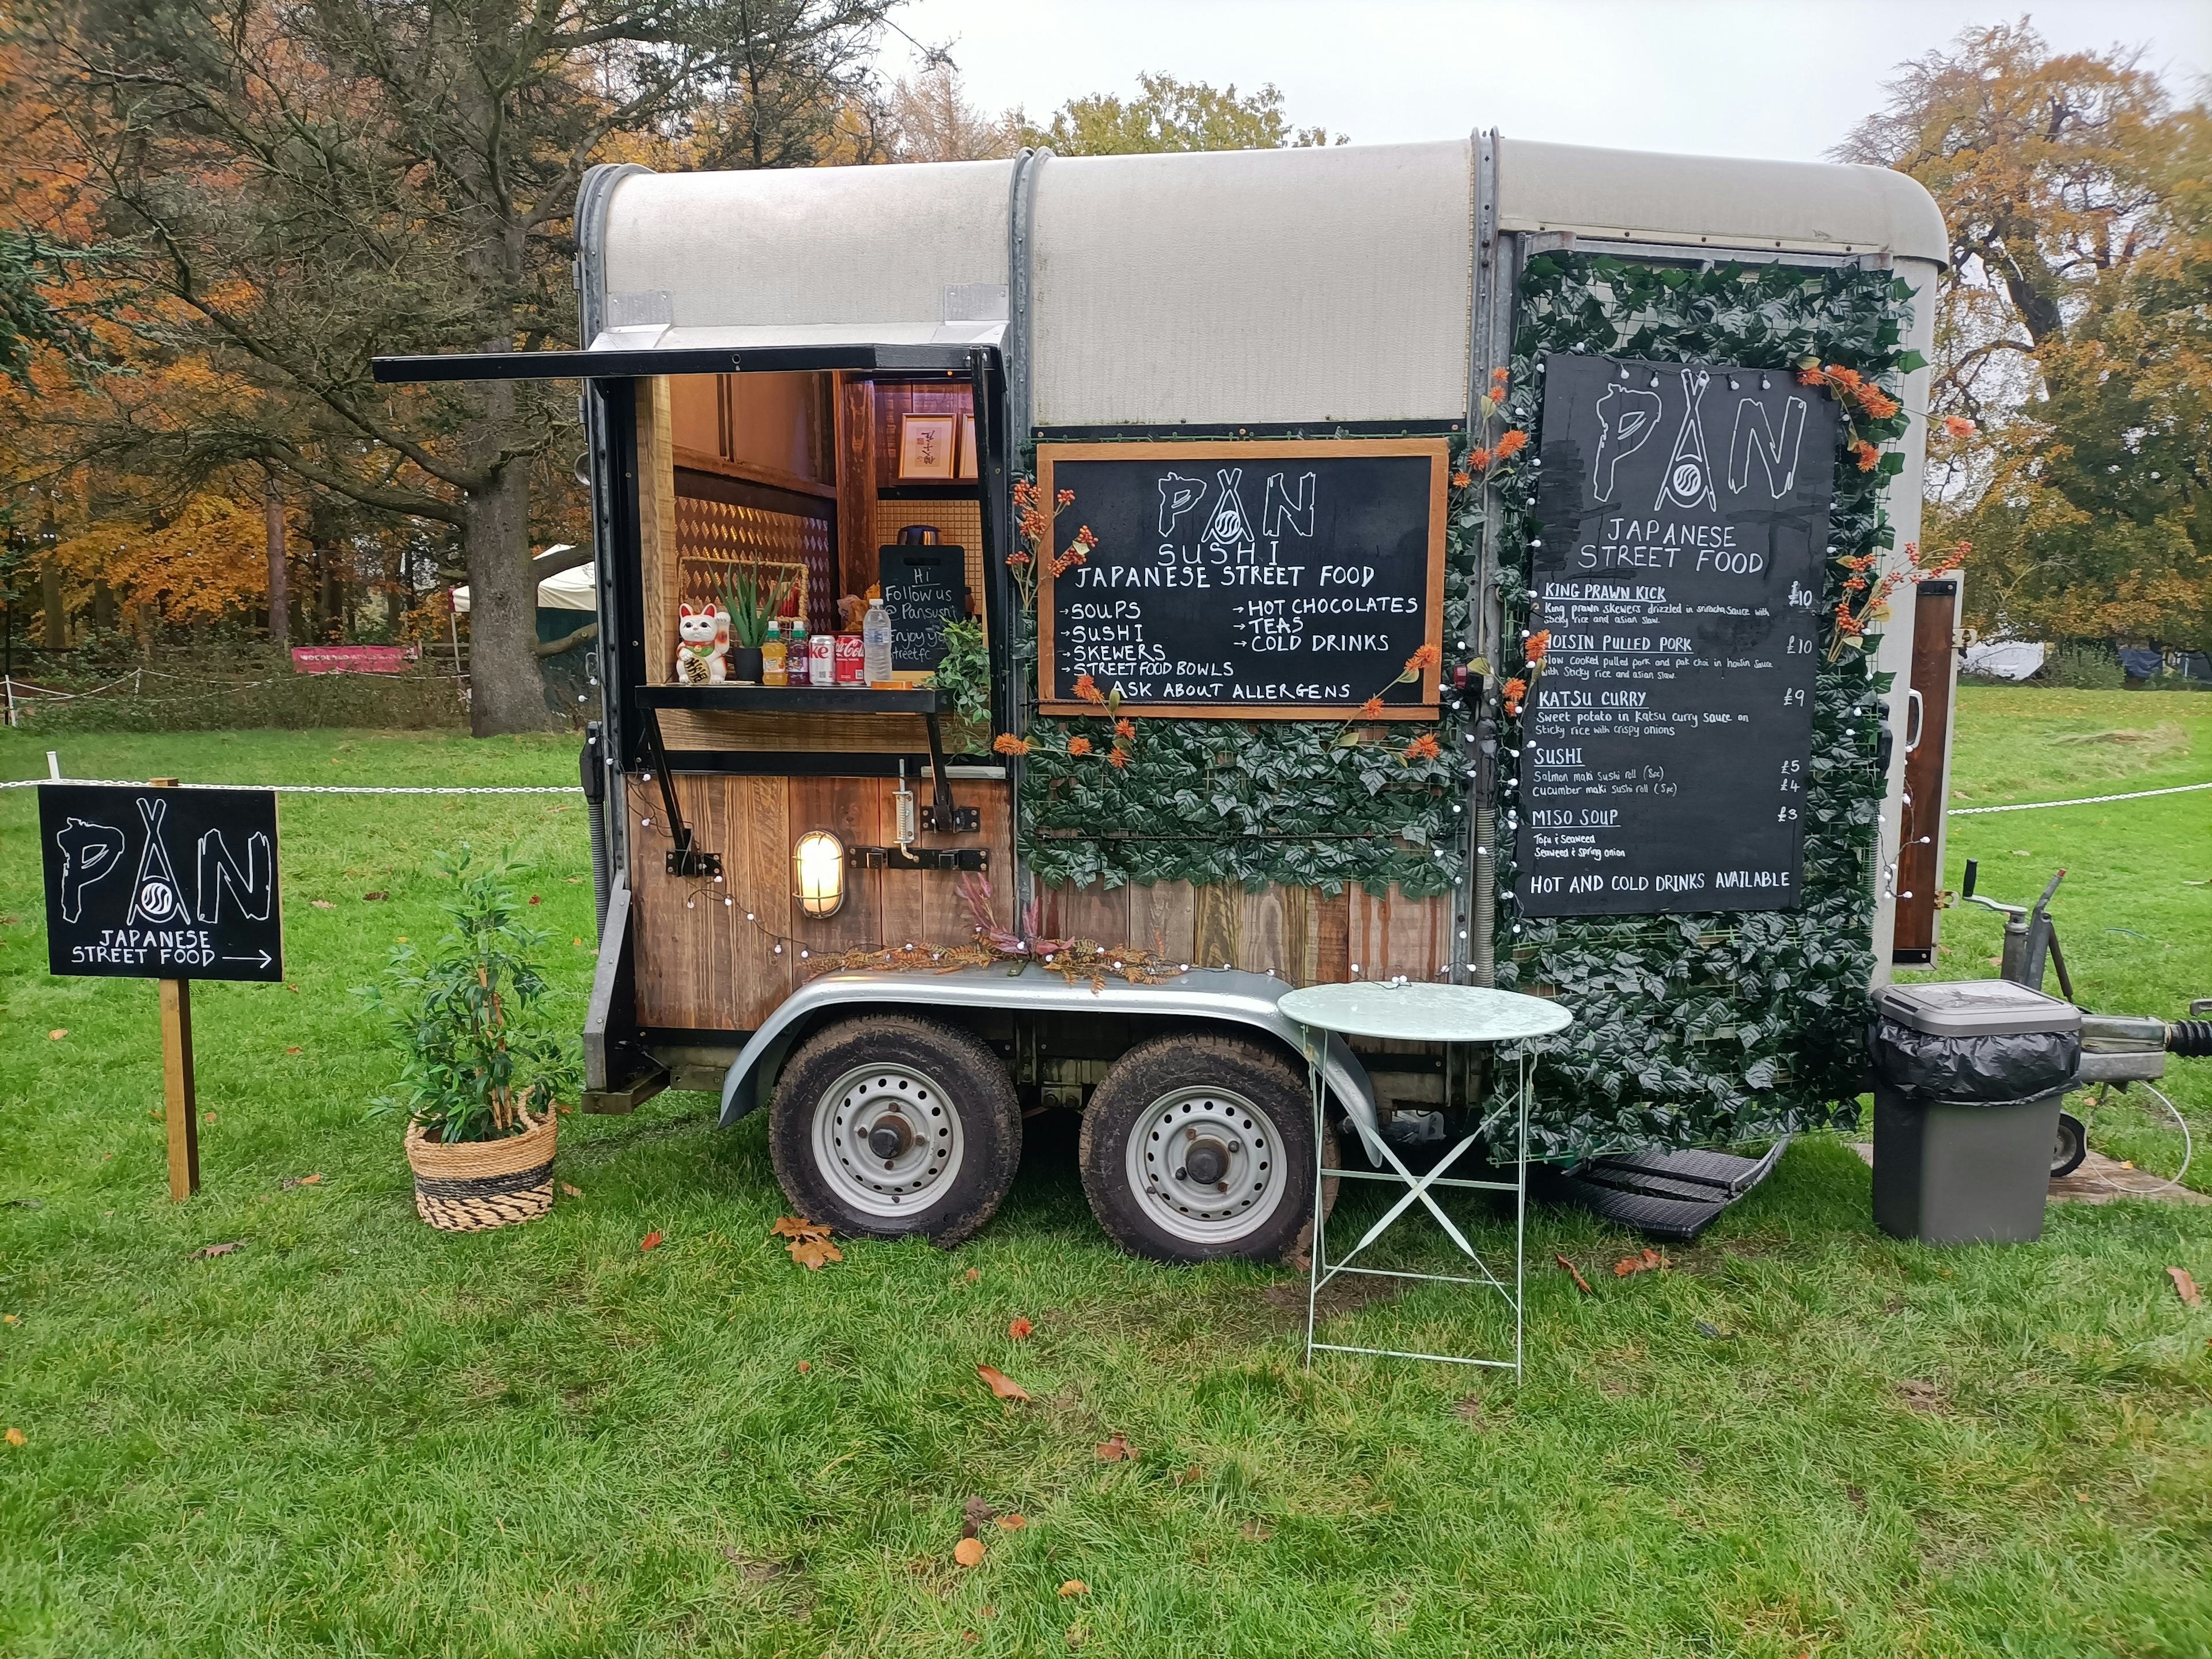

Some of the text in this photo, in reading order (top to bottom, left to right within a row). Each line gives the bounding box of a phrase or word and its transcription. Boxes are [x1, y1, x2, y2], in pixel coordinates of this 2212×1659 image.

[1608, 518, 1736, 547] JAPANESE
[1157, 541, 1279, 566] SUSHI
[1578, 545, 1763, 573] STREET FOOD
[914, 567, 931, 584] Hi
[1075, 566, 1374, 589] JAPANESE STREET FOOD
[885, 585, 952, 603] Follow us
[1546, 582, 1666, 600] KING PRAWN KICK
[1788, 581, 1812, 606] £10
[1071, 600, 1142, 620] SOUPS
[1248, 597, 1418, 616] HOT CHOCOLATES
[1544, 602, 1565, 619] King
[1571, 604, 1600, 619] prawn
[1603, 603, 1641, 614] skewers
[1648, 604, 1682, 614] drizzled
[1686, 605, 1694, 613] in
[1755, 608, 1770, 616] with
[1249, 616, 1304, 634] TEAS
[1574, 615, 1589, 624] rice
[1593, 615, 1609, 624] and
[1614, 615, 1638, 624] asian
[891, 628, 925, 649] Enjoy
[1072, 624, 1143, 642] SUSHI
[810, 643, 829, 659] ke
[1252, 634, 1389, 652] COLD DRINKS
[1603, 635, 1651, 651] PULLED
[1660, 637, 1692, 651] PORK
[1787, 635, 1812, 654] £10
[1073, 645, 1166, 662] SKEWERS
[1073, 660, 1234, 677] STREET FOOD BOWLS
[1603, 657, 1628, 668] pulled
[1633, 658, 1651, 668] pork
[1655, 658, 1670, 666] and
[1676, 657, 1690, 668] pak
[1694, 658, 1709, 666] choi
[1714, 658, 1722, 666] in
[1727, 657, 1750, 668] hoisin
[1594, 669, 1612, 677] rice
[1616, 670, 1629, 679] and
[1633, 671, 1654, 679] asian
[1112, 683, 1350, 699] ASK ABOUT ALLERGENS
[1539, 691, 1646, 707] KATSU CURRY
[1783, 687, 1805, 707] £9
[1536, 711, 1571, 722] Sweet
[1577, 711, 1612, 725] potato
[1618, 711, 1629, 721] in
[1672, 713, 1698, 728] curry
[1738, 714, 1749, 722] on
[1535, 725, 1565, 738] Sticky
[1571, 726, 1590, 735] rice
[1614, 725, 1639, 737] crispy
[1644, 725, 1675, 736] onions
[1534, 748, 1582, 765] SUSHI
[1533, 770, 1569, 782] Salmon
[1573, 771, 1593, 782] maki
[1624, 769, 1637, 779] roll
[1781, 760, 1800, 775] £5
[1585, 783, 1607, 795] maki
[1635, 784, 1648, 793] roll
[1780, 778, 1801, 793] £4
[1532, 809, 1618, 825] MISO SOUP
[1778, 806, 1797, 822] £3
[1533, 833, 1552, 846] Tofu
[1560, 835, 1596, 844] Seaweed
[1535, 847, 1569, 858] Seaweed
[1604, 848, 1626, 857] onion
[1531, 871, 1790, 894] HOT AND COLD DRINKS AVAILABLE
[99, 929, 210, 948] JAPANESE
[71, 946, 215, 967] STREET FOOD
